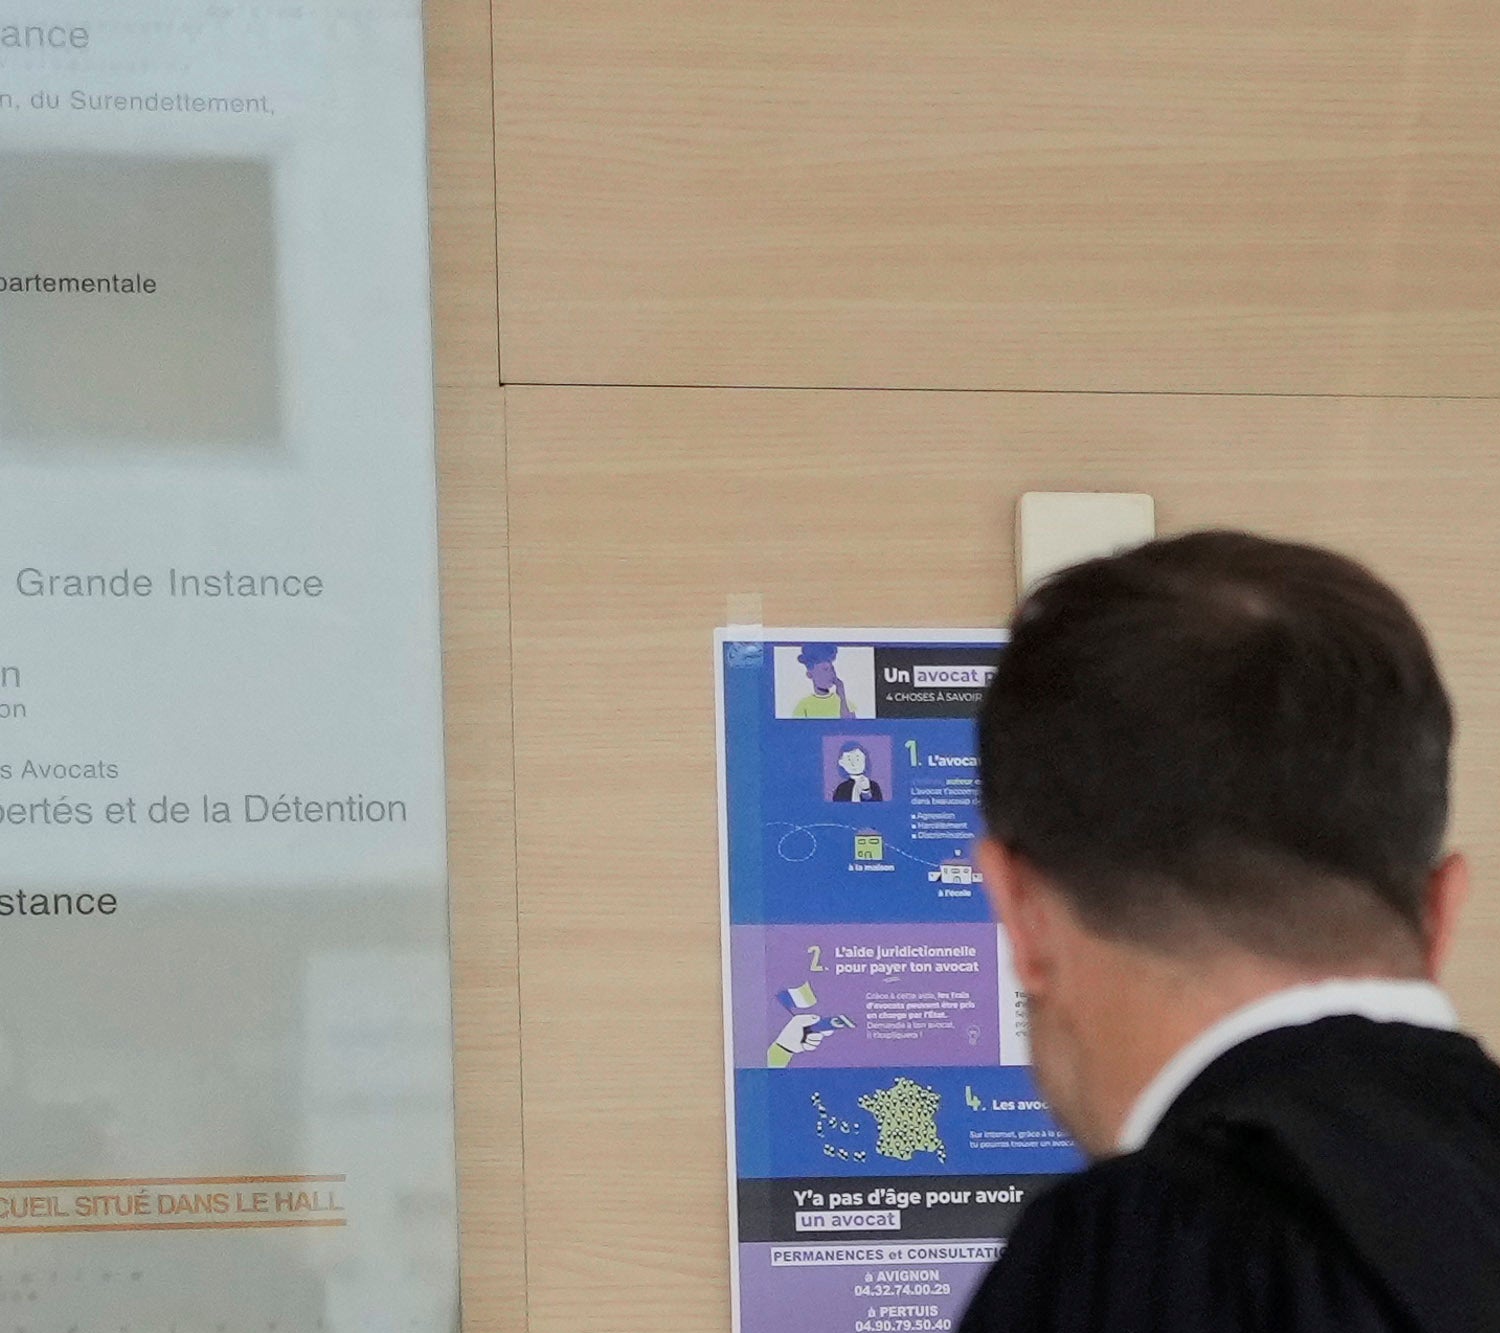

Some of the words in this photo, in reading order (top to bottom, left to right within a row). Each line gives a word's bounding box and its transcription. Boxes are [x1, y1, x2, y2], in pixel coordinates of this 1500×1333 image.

[30, 90, 60, 110] du
[70, 90, 275, 116] Surendettement,
[16, 568, 152, 597] Grande
[169, 568, 324, 597] Instance
[883, 667, 911, 683] Un
[917, 669, 979, 683] avocat
[894, 692, 935, 702] CHOSES
[21, 759, 119, 780] Avocats
[105, 798, 137, 824] et
[147, 795, 191, 824] de
[203, 794, 233, 823] la
[244, 793, 408, 823] Détention
[835, 946, 874, 958] L'aide
[876, 946, 976, 960] juridictionnelle
[835, 963, 867, 975] pour
[870, 963, 907, 976] payer
[910, 962, 932, 973] ton
[935, 962, 979, 973] avocat
[992, 1100, 1015, 1111] Les
[75, 1188, 151, 1216] SITUÉ
[158, 1193, 229, 1215] DANS
[237, 1192, 271, 1213] LE
[275, 1190, 345, 1212] HALL
[793, 1189, 824, 1207] Y'a
[829, 1191, 864, 1209] pas
[867, 1188, 922, 1208] d'âge
[926, 1190, 970, 1208] pour
[975, 1185, 1024, 1203] avoir
[801, 1215, 825, 1227] un
[831, 1212, 896, 1227] avocat
[773, 1249, 884, 1262] PERMANENCES
[889, 1249, 902, 1260] et
[864, 1271, 873, 1282] à
[877, 1270, 939, 1282] AVIGNON
[880, 1305, 939, 1317] PERTUIS
